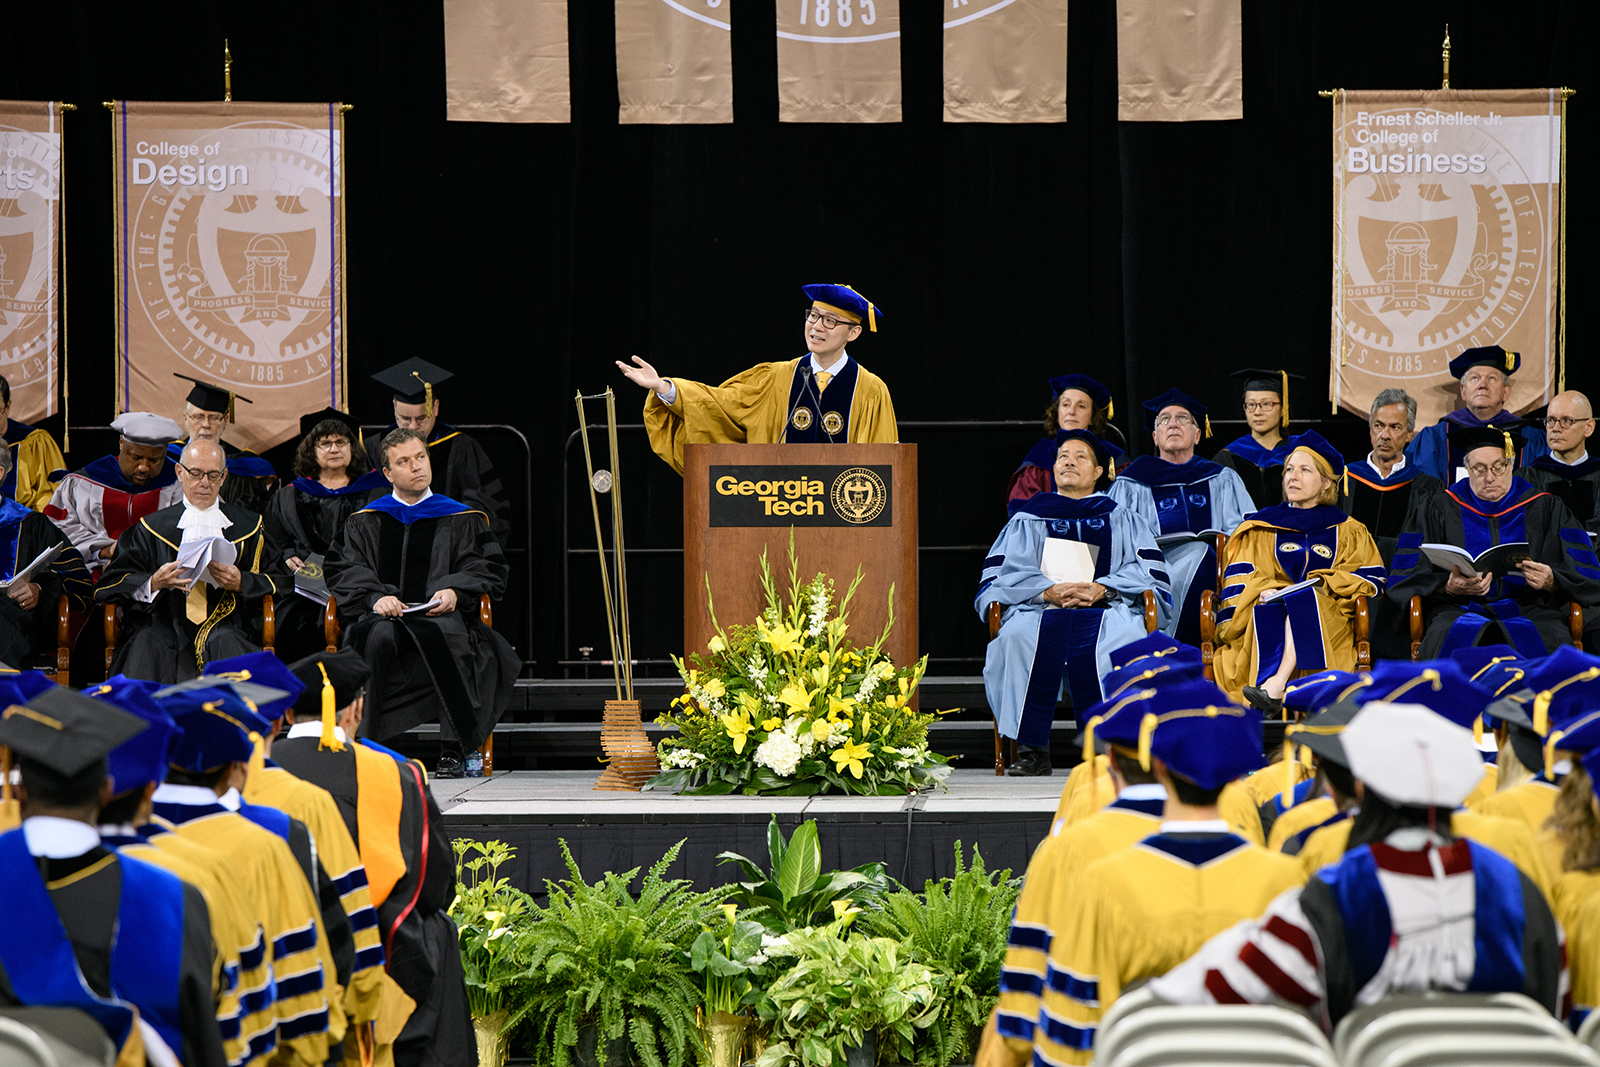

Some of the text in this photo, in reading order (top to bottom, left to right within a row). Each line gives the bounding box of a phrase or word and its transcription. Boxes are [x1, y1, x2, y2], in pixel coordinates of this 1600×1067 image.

[800, 0, 876, 27] 1885
[1357, 111, 1502, 126] Ernest Scheller Jr.
[1357, 129, 1418, 147] College
[1423, 128, 1439, 144] of
[136, 141, 221, 159] College of
[1348, 147, 1487, 174] Business
[0, 164, 34, 191] ts
[132, 157, 249, 192] Design
[1514, 195, 1535, 217] OF
[138, 231, 156, 269] THE
[194, 296, 251, 308] PROGRESS
[1429, 287, 1475, 297] SERVICE
[148, 298, 171, 320] OF
[256, 310, 278, 318] AND
[1395, 300, 1418, 309] AND
[182, 336, 230, 375] SEAL
[1389, 355, 1423, 373] 1885
[250, 364, 284, 382] 1885
[715, 476, 825, 500] Georgia
[758, 496, 825, 516] Tech
